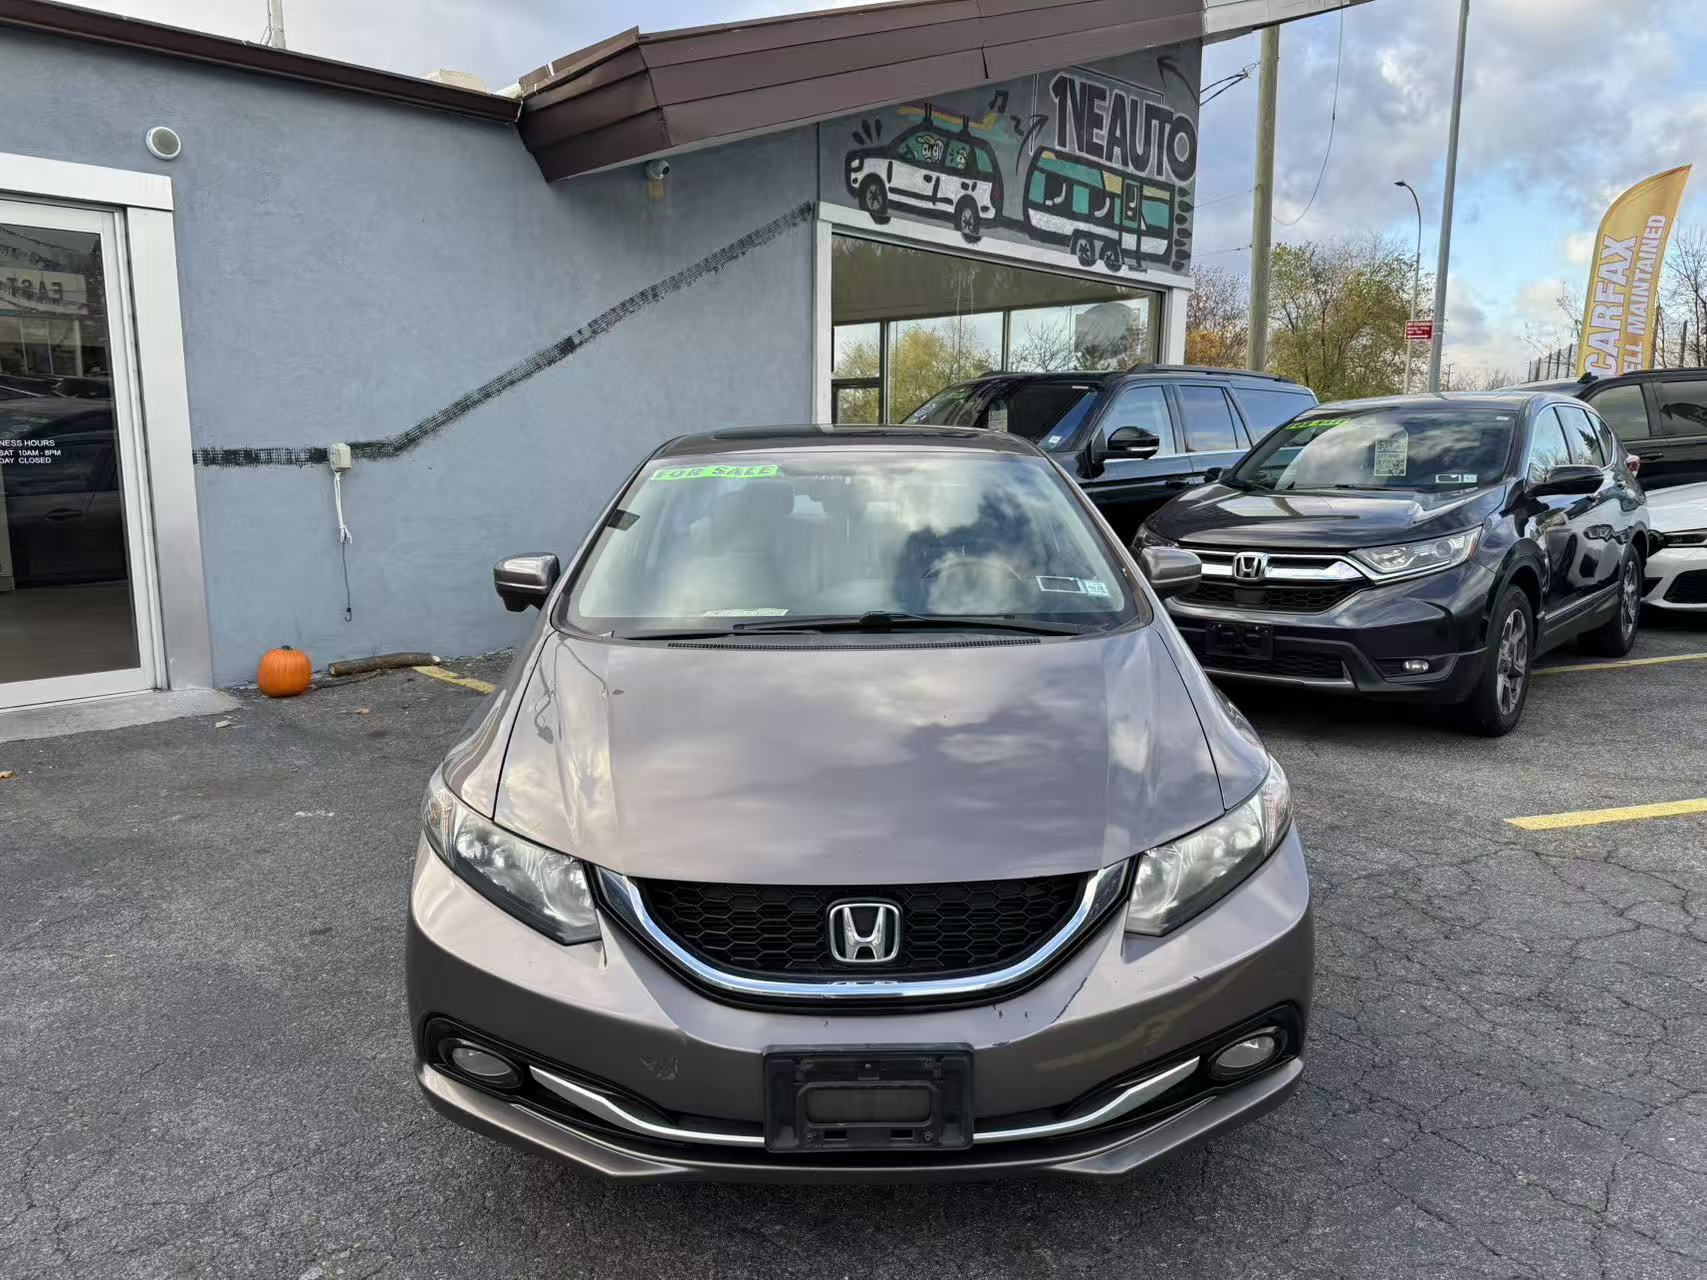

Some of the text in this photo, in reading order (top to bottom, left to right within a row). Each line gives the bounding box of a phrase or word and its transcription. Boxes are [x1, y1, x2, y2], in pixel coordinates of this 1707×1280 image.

[1584, 234, 1637, 377] CARFAX
[1626, 215, 1666, 336] MAINTAINED
[654, 465, 777, 480] FOR SALE
